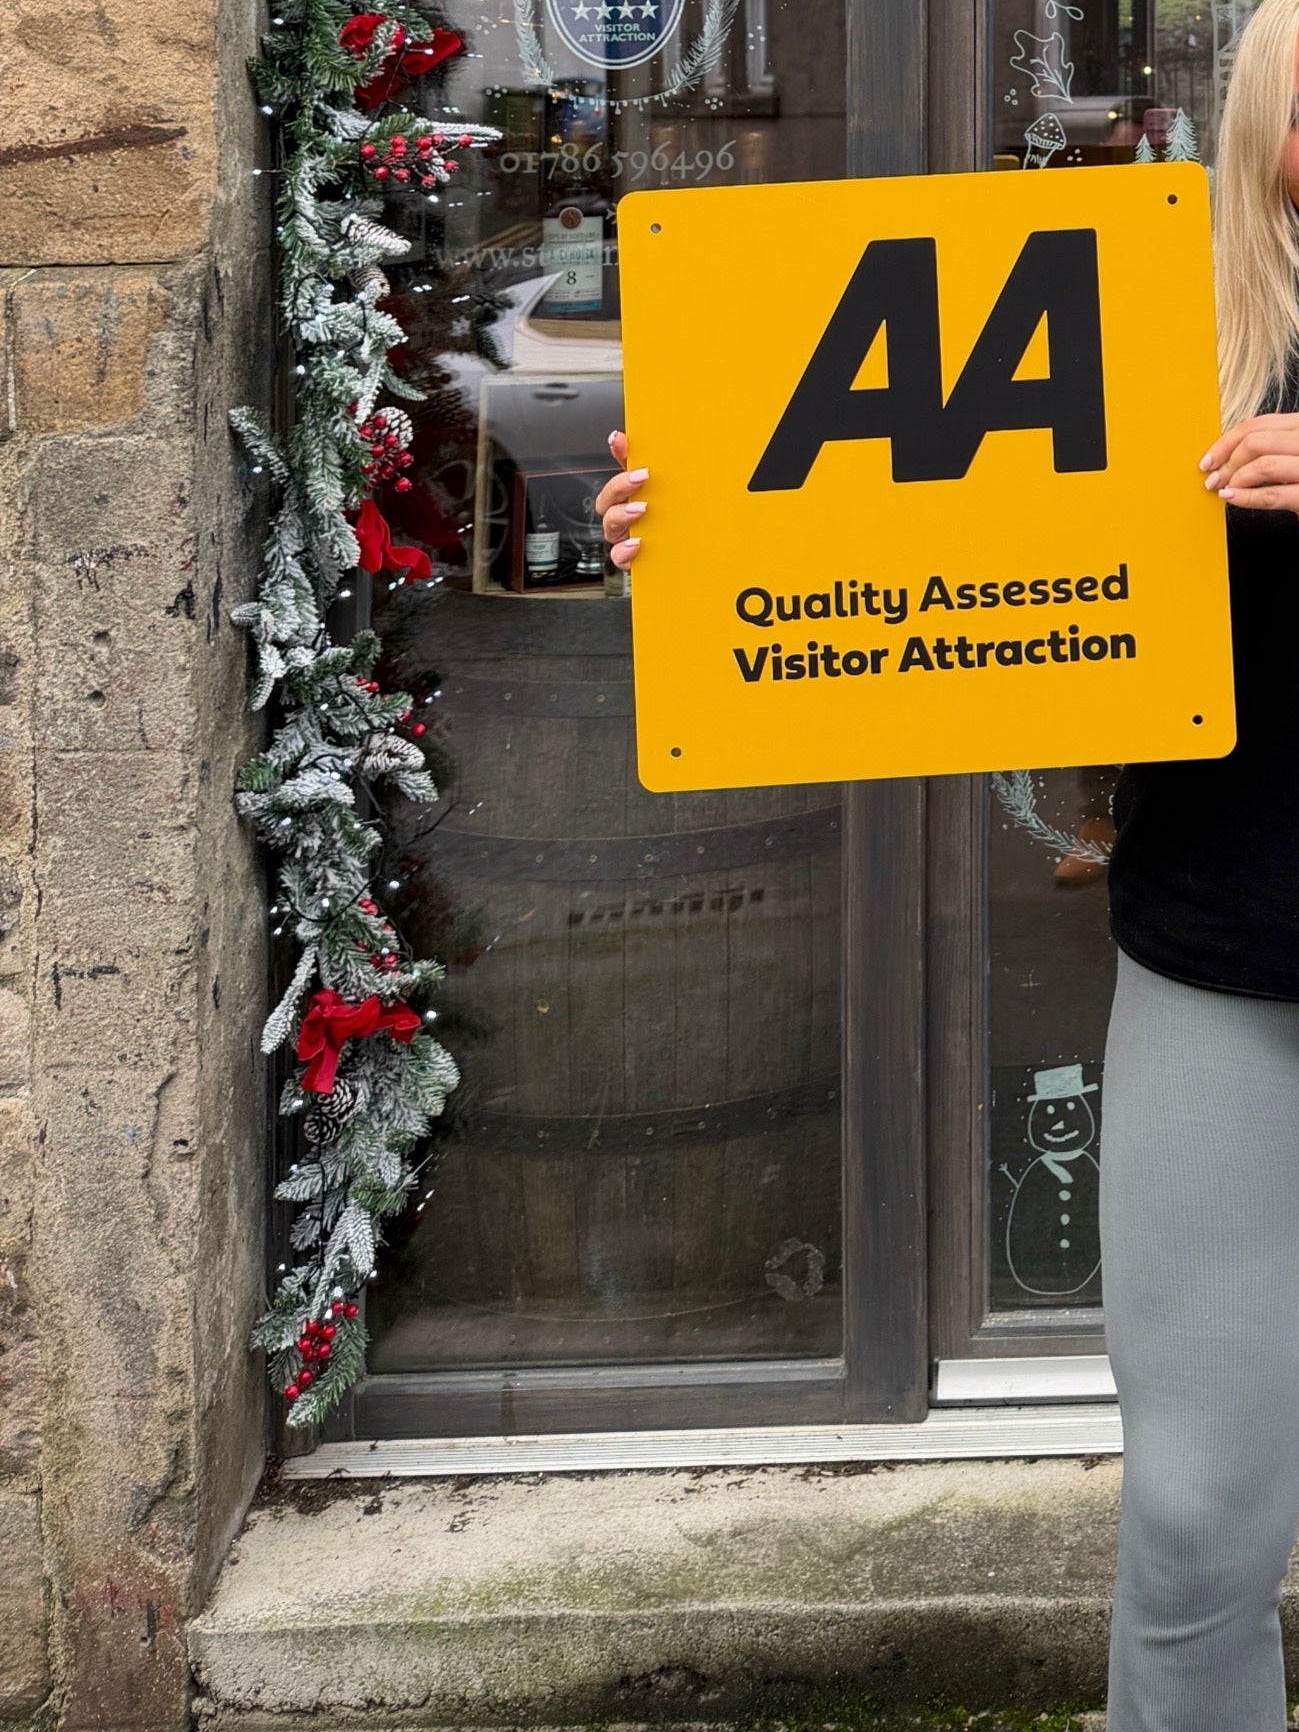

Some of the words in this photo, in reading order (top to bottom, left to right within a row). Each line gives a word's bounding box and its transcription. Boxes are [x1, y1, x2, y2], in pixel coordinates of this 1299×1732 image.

[579, 32, 656, 43] ATTRACTION
[594, 23, 640, 33] VISITOR
[500, 142, 604, 180] 01786
[611, 140, 737, 181] 596496
[566, 270, 578, 286] 8
[747, 228, 1108, 493] AA
[735, 580, 908, 627] Quality
[919, 563, 1130, 613] Assessed
[734, 641, 888, 682] Visitor
[898, 625, 1137, 673] Attraction
